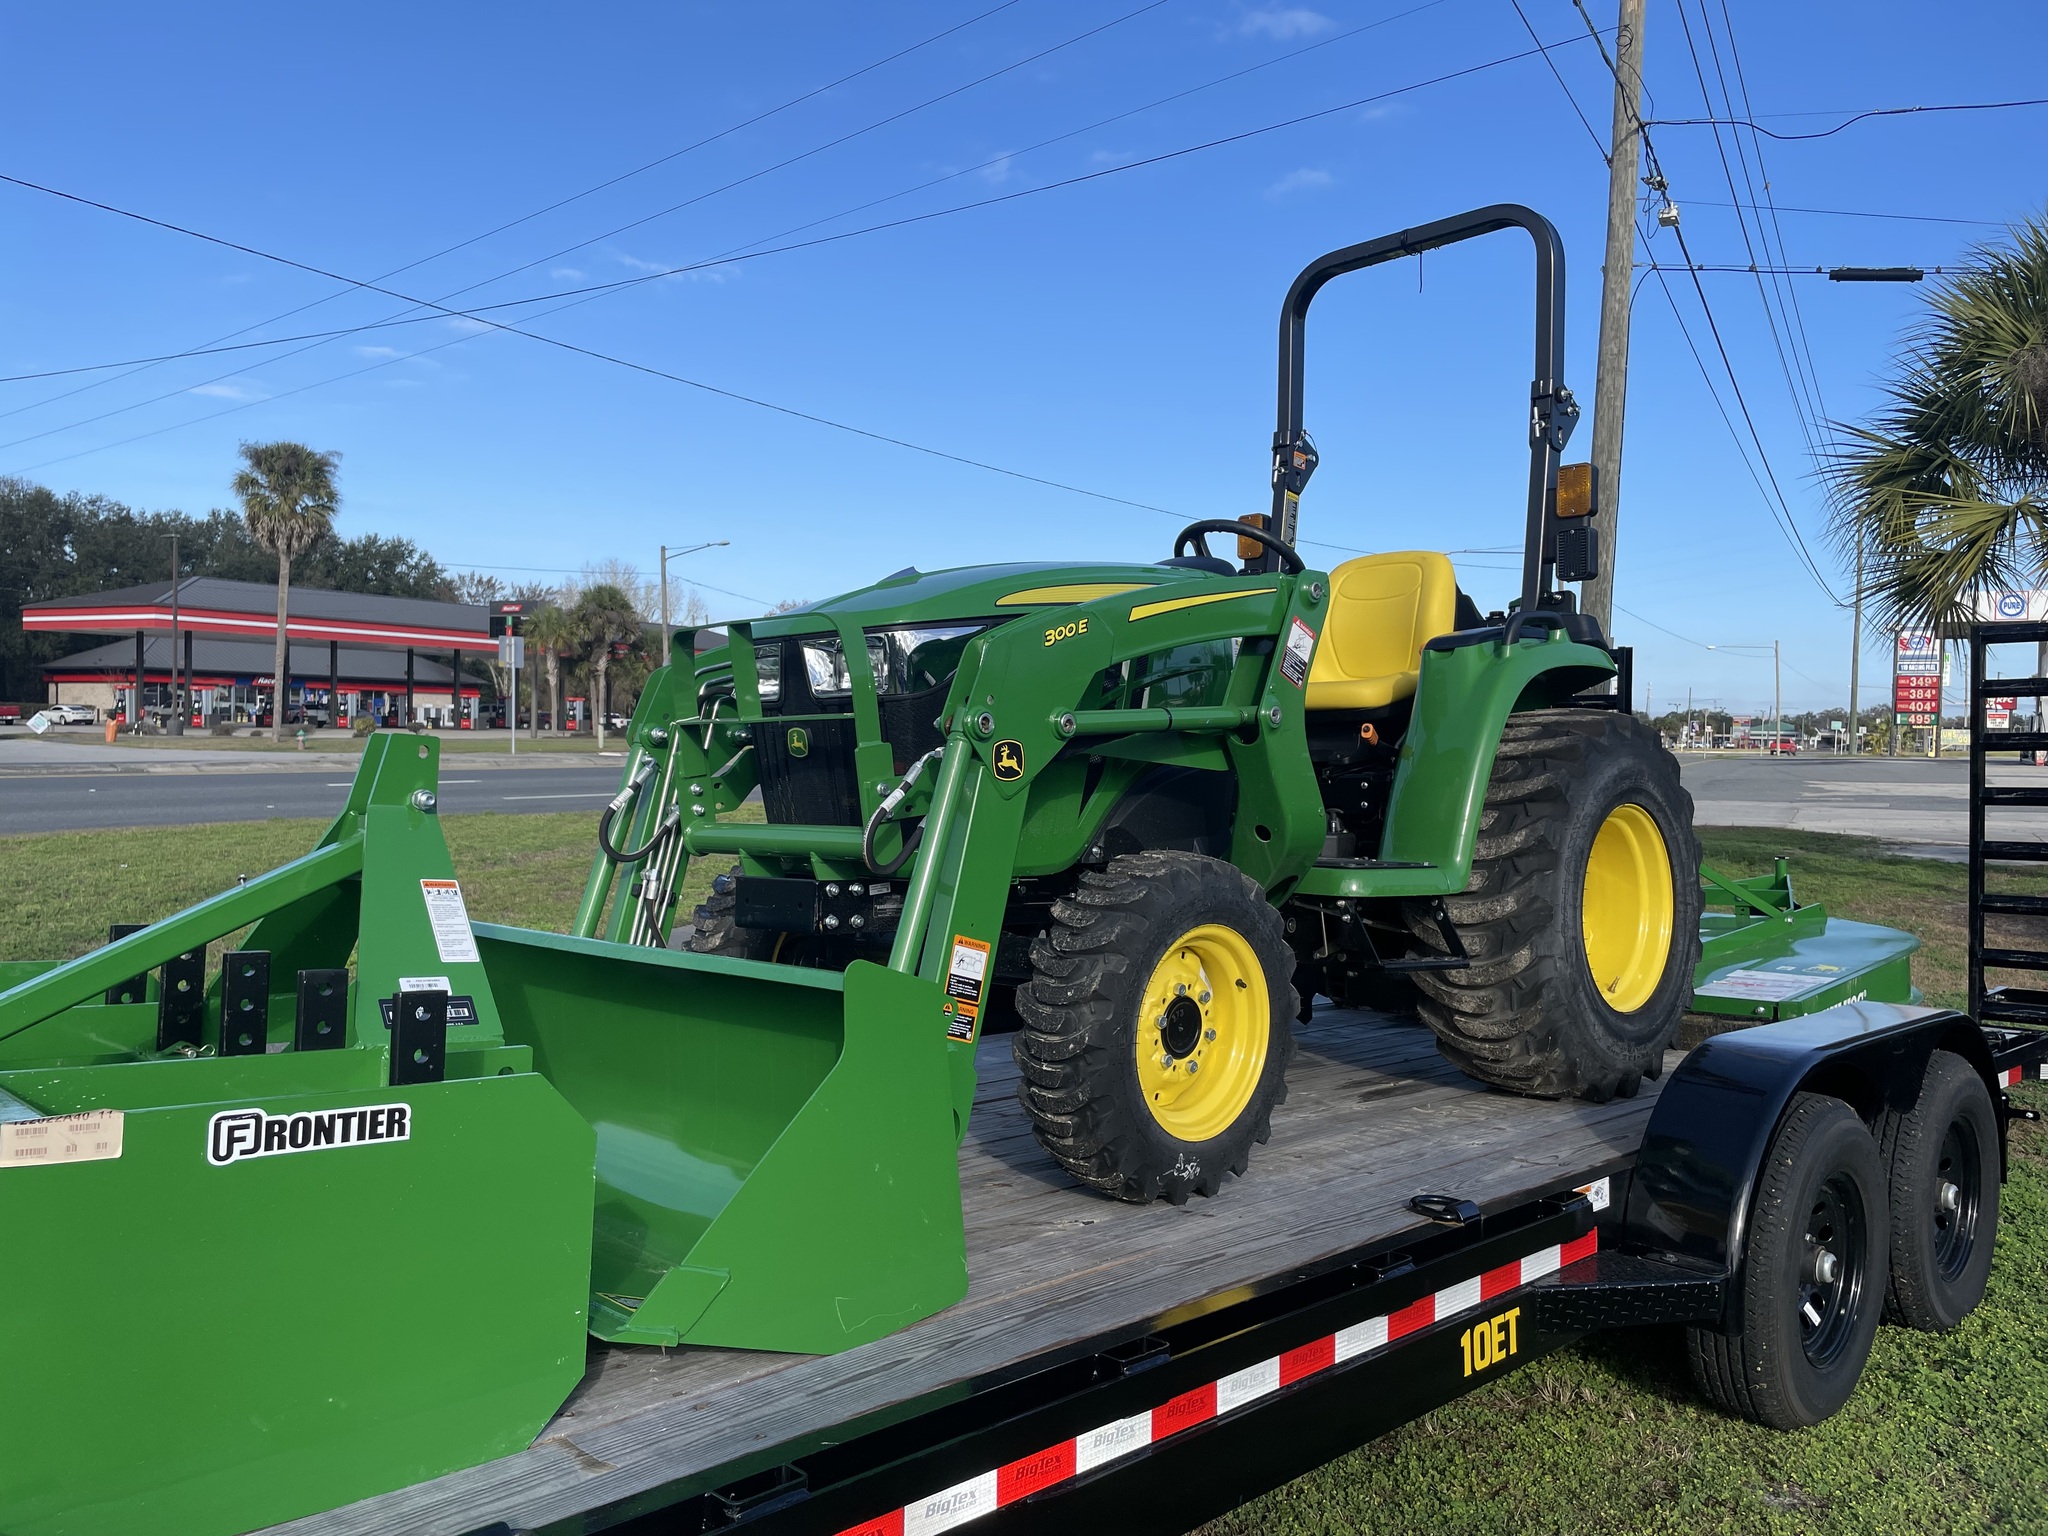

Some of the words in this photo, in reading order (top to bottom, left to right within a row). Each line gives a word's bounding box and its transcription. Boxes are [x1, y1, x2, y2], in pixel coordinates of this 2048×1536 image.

[2003, 601, 2020, 610] PURE
[258, 677, 275, 685] Race
[964, 940, 987, 951] WARNING
[958, 1004, 975, 1015] RNING
[211, 1106, 408, 1163] FRONTIER
[1460, 1306, 1521, 1378] 10ET
[924, 1487, 978, 1519] BigTex
